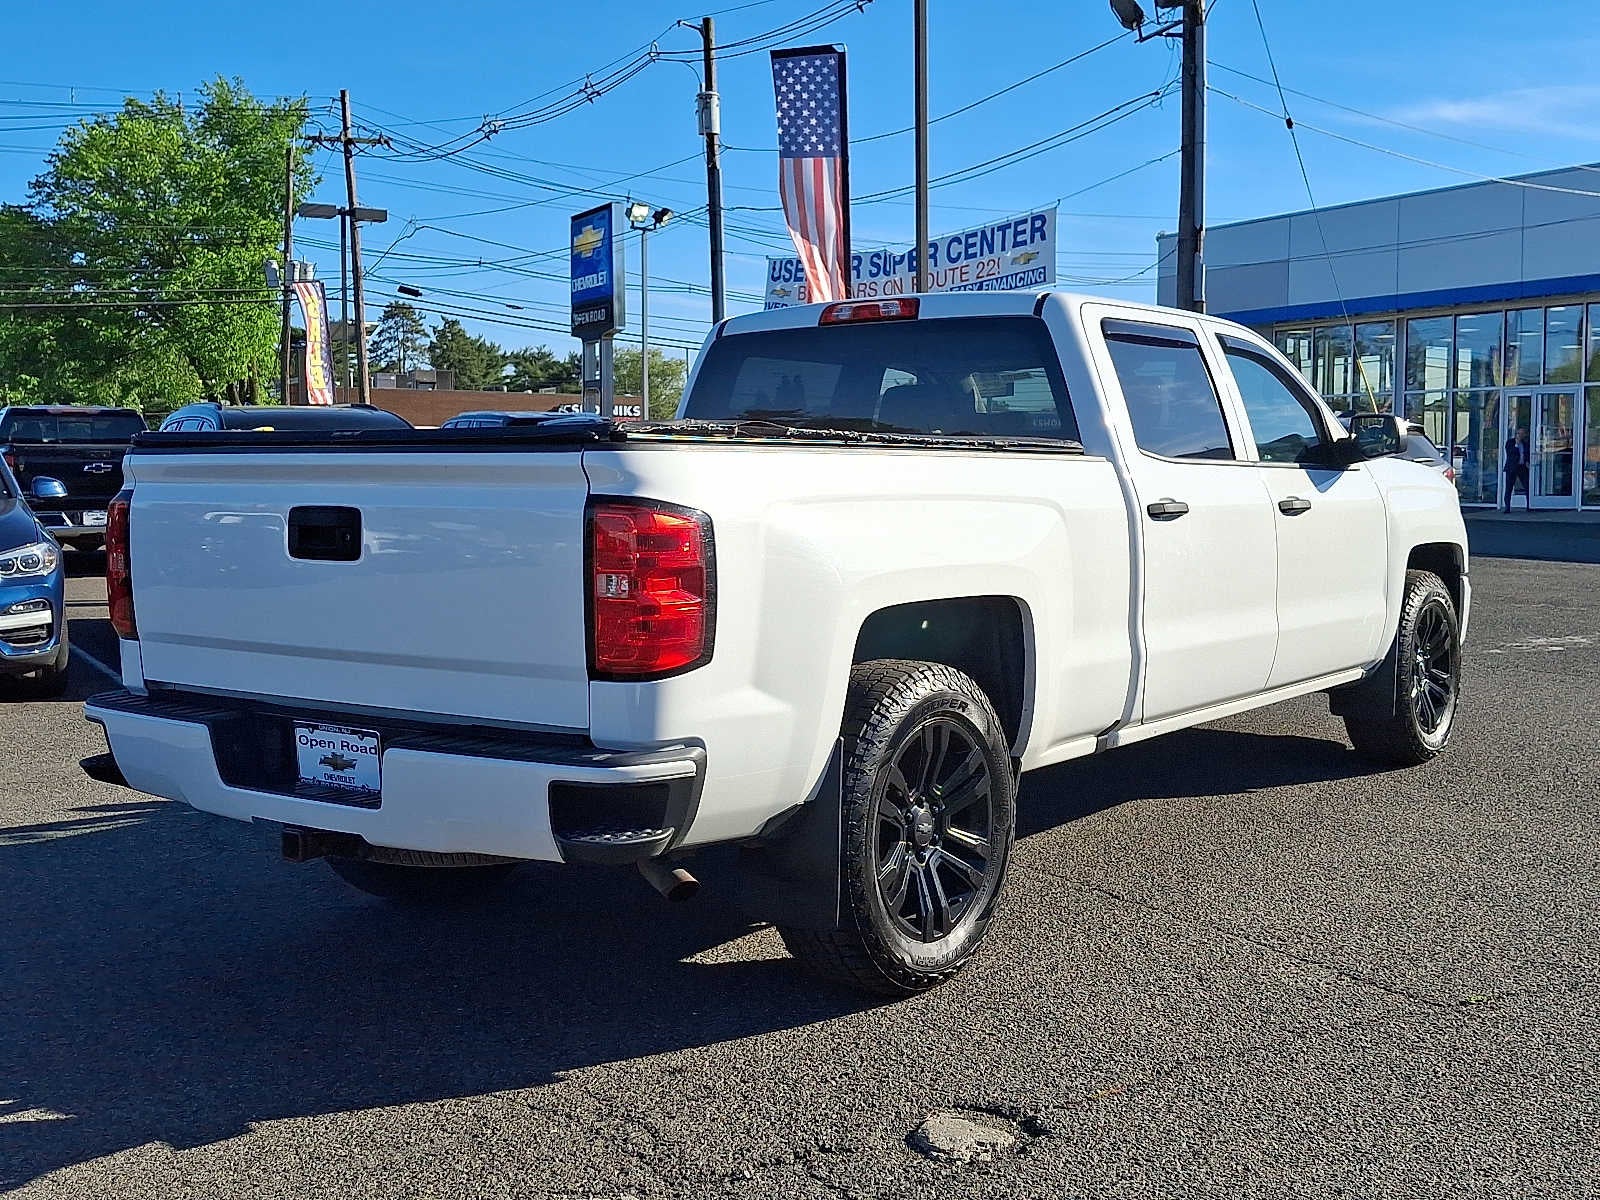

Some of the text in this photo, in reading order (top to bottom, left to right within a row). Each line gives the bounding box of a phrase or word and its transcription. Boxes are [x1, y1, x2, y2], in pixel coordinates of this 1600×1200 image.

[869, 242, 939, 278] SUPER
[946, 214, 1047, 264] CENTER
[771, 259, 807, 282] USE
[982, 268, 1046, 291] FINANCING
[572, 271, 607, 293] CHEVROLET
[883, 278, 903, 296] ON
[590, 309, 606, 322] ROAD
[298, 734, 378, 755] Open Road
